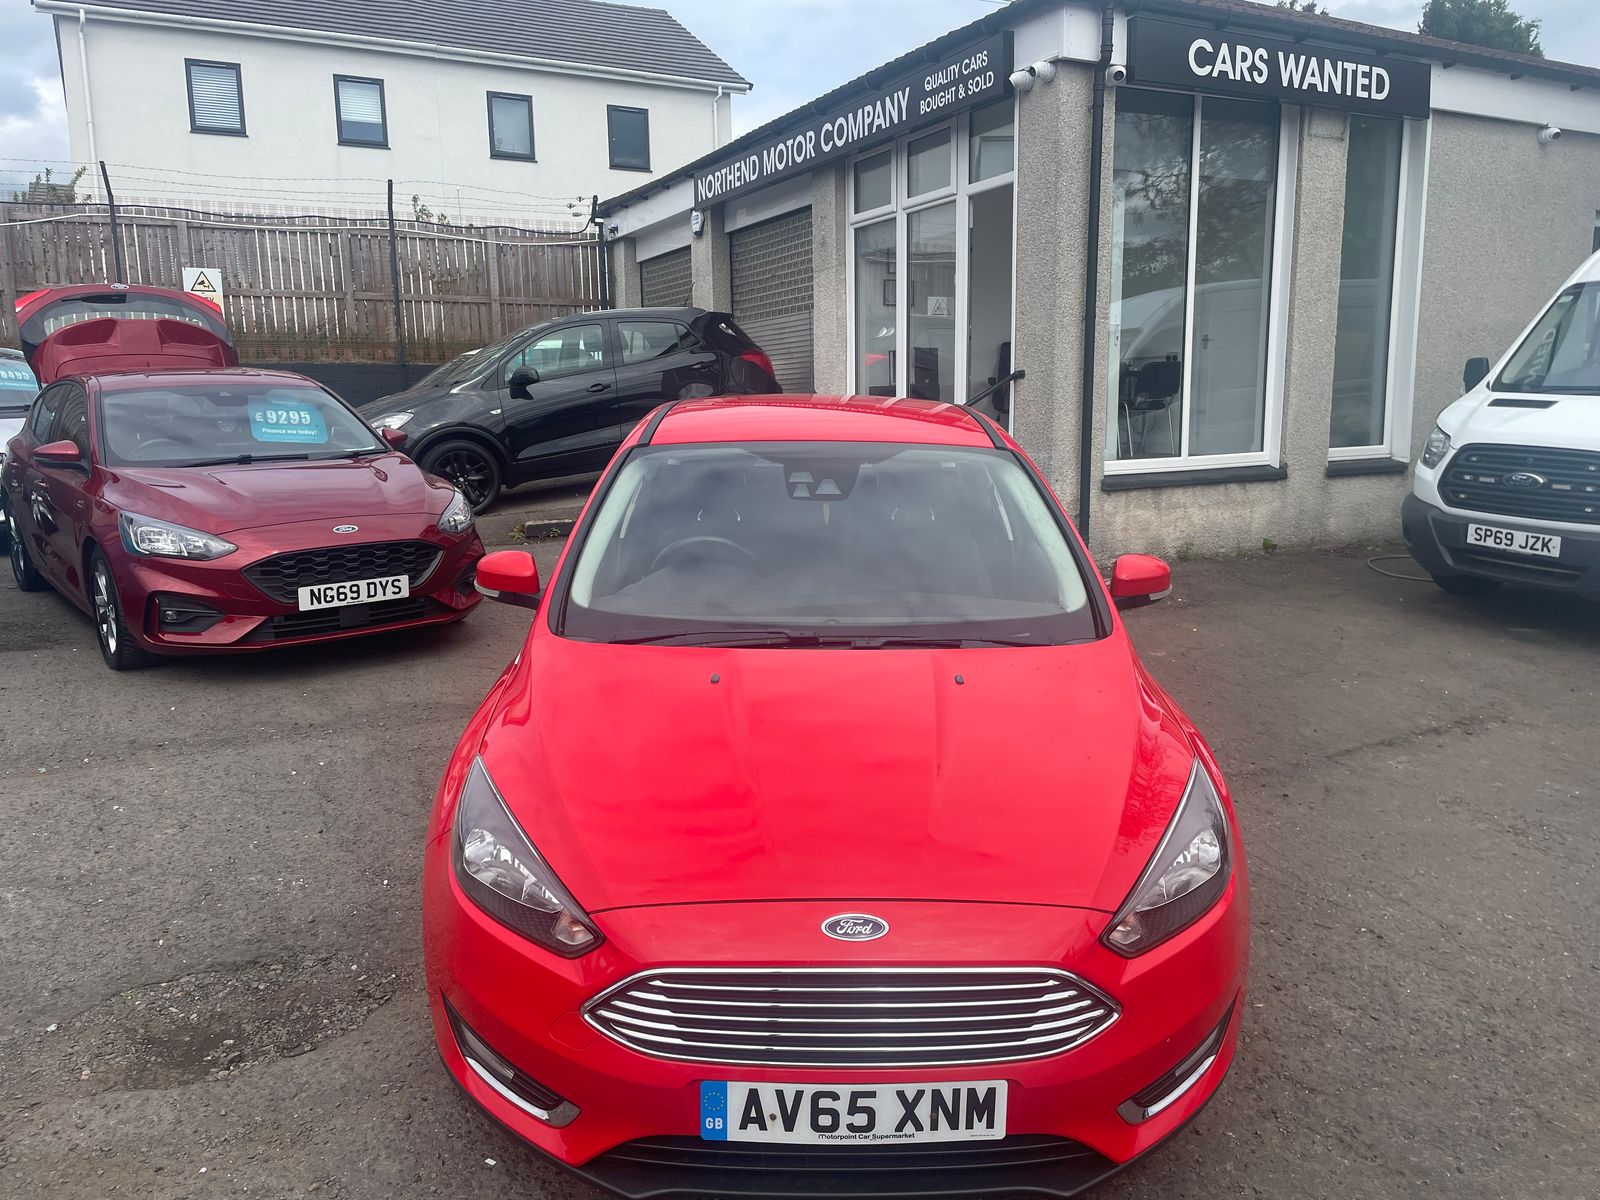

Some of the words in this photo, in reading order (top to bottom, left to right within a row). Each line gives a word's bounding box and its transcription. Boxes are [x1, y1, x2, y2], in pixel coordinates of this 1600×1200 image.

[924, 62, 960, 91] QUALITY
[962, 50, 988, 75] CARS
[1188, 38, 1269, 84] CARS
[1278, 51, 1390, 100] WANTED
[920, 86, 956, 115] BOUGHT
[958, 84, 966, 99] &
[967, 71, 994, 95] SOLD
[697, 155, 759, 201] NORTHEND
[763, 131, 816, 175] MOTOR
[820, 87, 910, 152] COMPANY
[1473, 527, 1514, 547] SP69
[1518, 534, 1553, 553] JZK
[309, 584, 360, 606] NG69
[366, 579, 402, 599] DYS
[836, 919, 873, 934] Ford
[705, 1117, 723, 1130] GB
[739, 1088, 877, 1134] AV65
[894, 1086, 997, 1133] XNM
[871, 1132, 915, 1140] Supermarket
